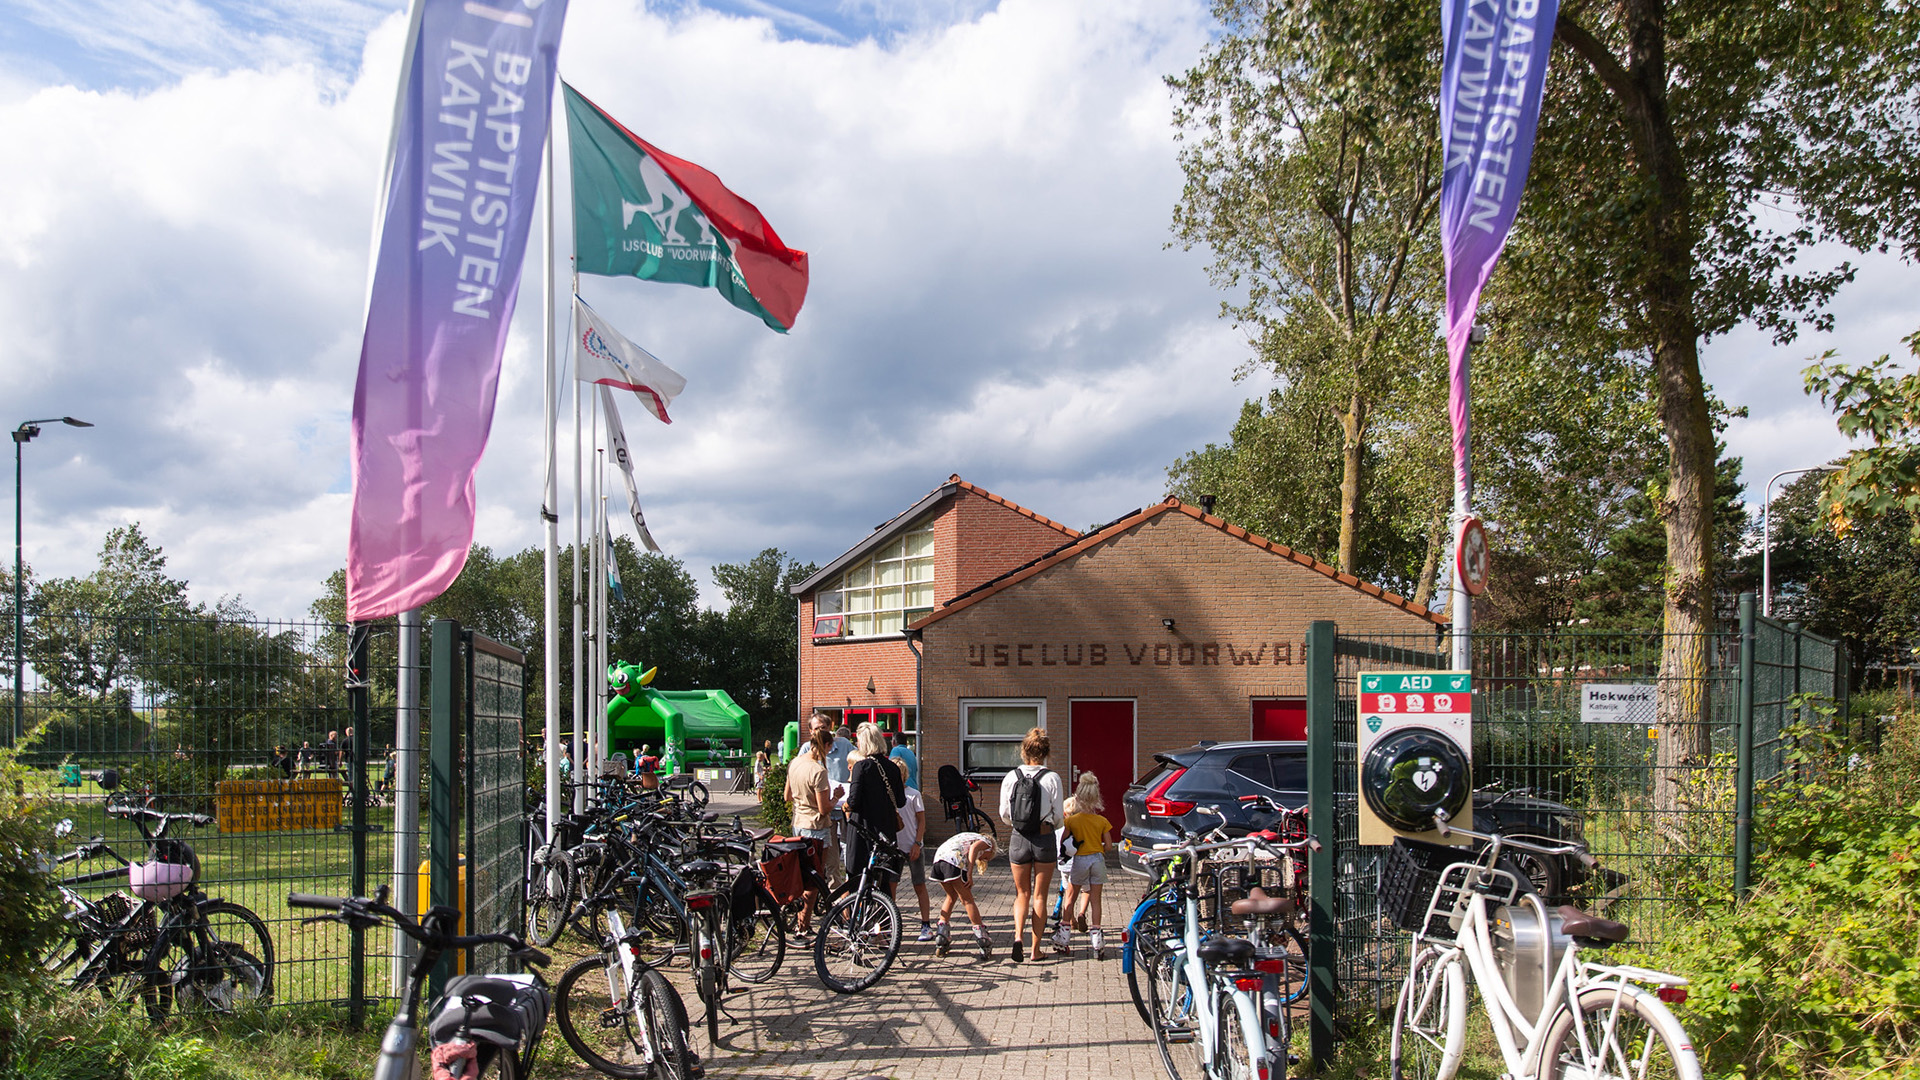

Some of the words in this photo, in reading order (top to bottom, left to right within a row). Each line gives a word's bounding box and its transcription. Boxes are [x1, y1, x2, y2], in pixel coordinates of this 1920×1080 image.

[1446, 0, 1500, 177] KATWIJK
[1469, 0, 1539, 235] BAPTISTEN
[418, 39, 489, 257] KATWIJK
[452, 50, 532, 319] BAPTISTEN
[622, 240, 664, 259] IJSCLUB
[969, 643, 1107, 667] IJSCLUB
[1399, 676, 1432, 690] AED
[1589, 691, 1649, 702] Hekwerk
[1589, 703, 1618, 711] Katwijk
